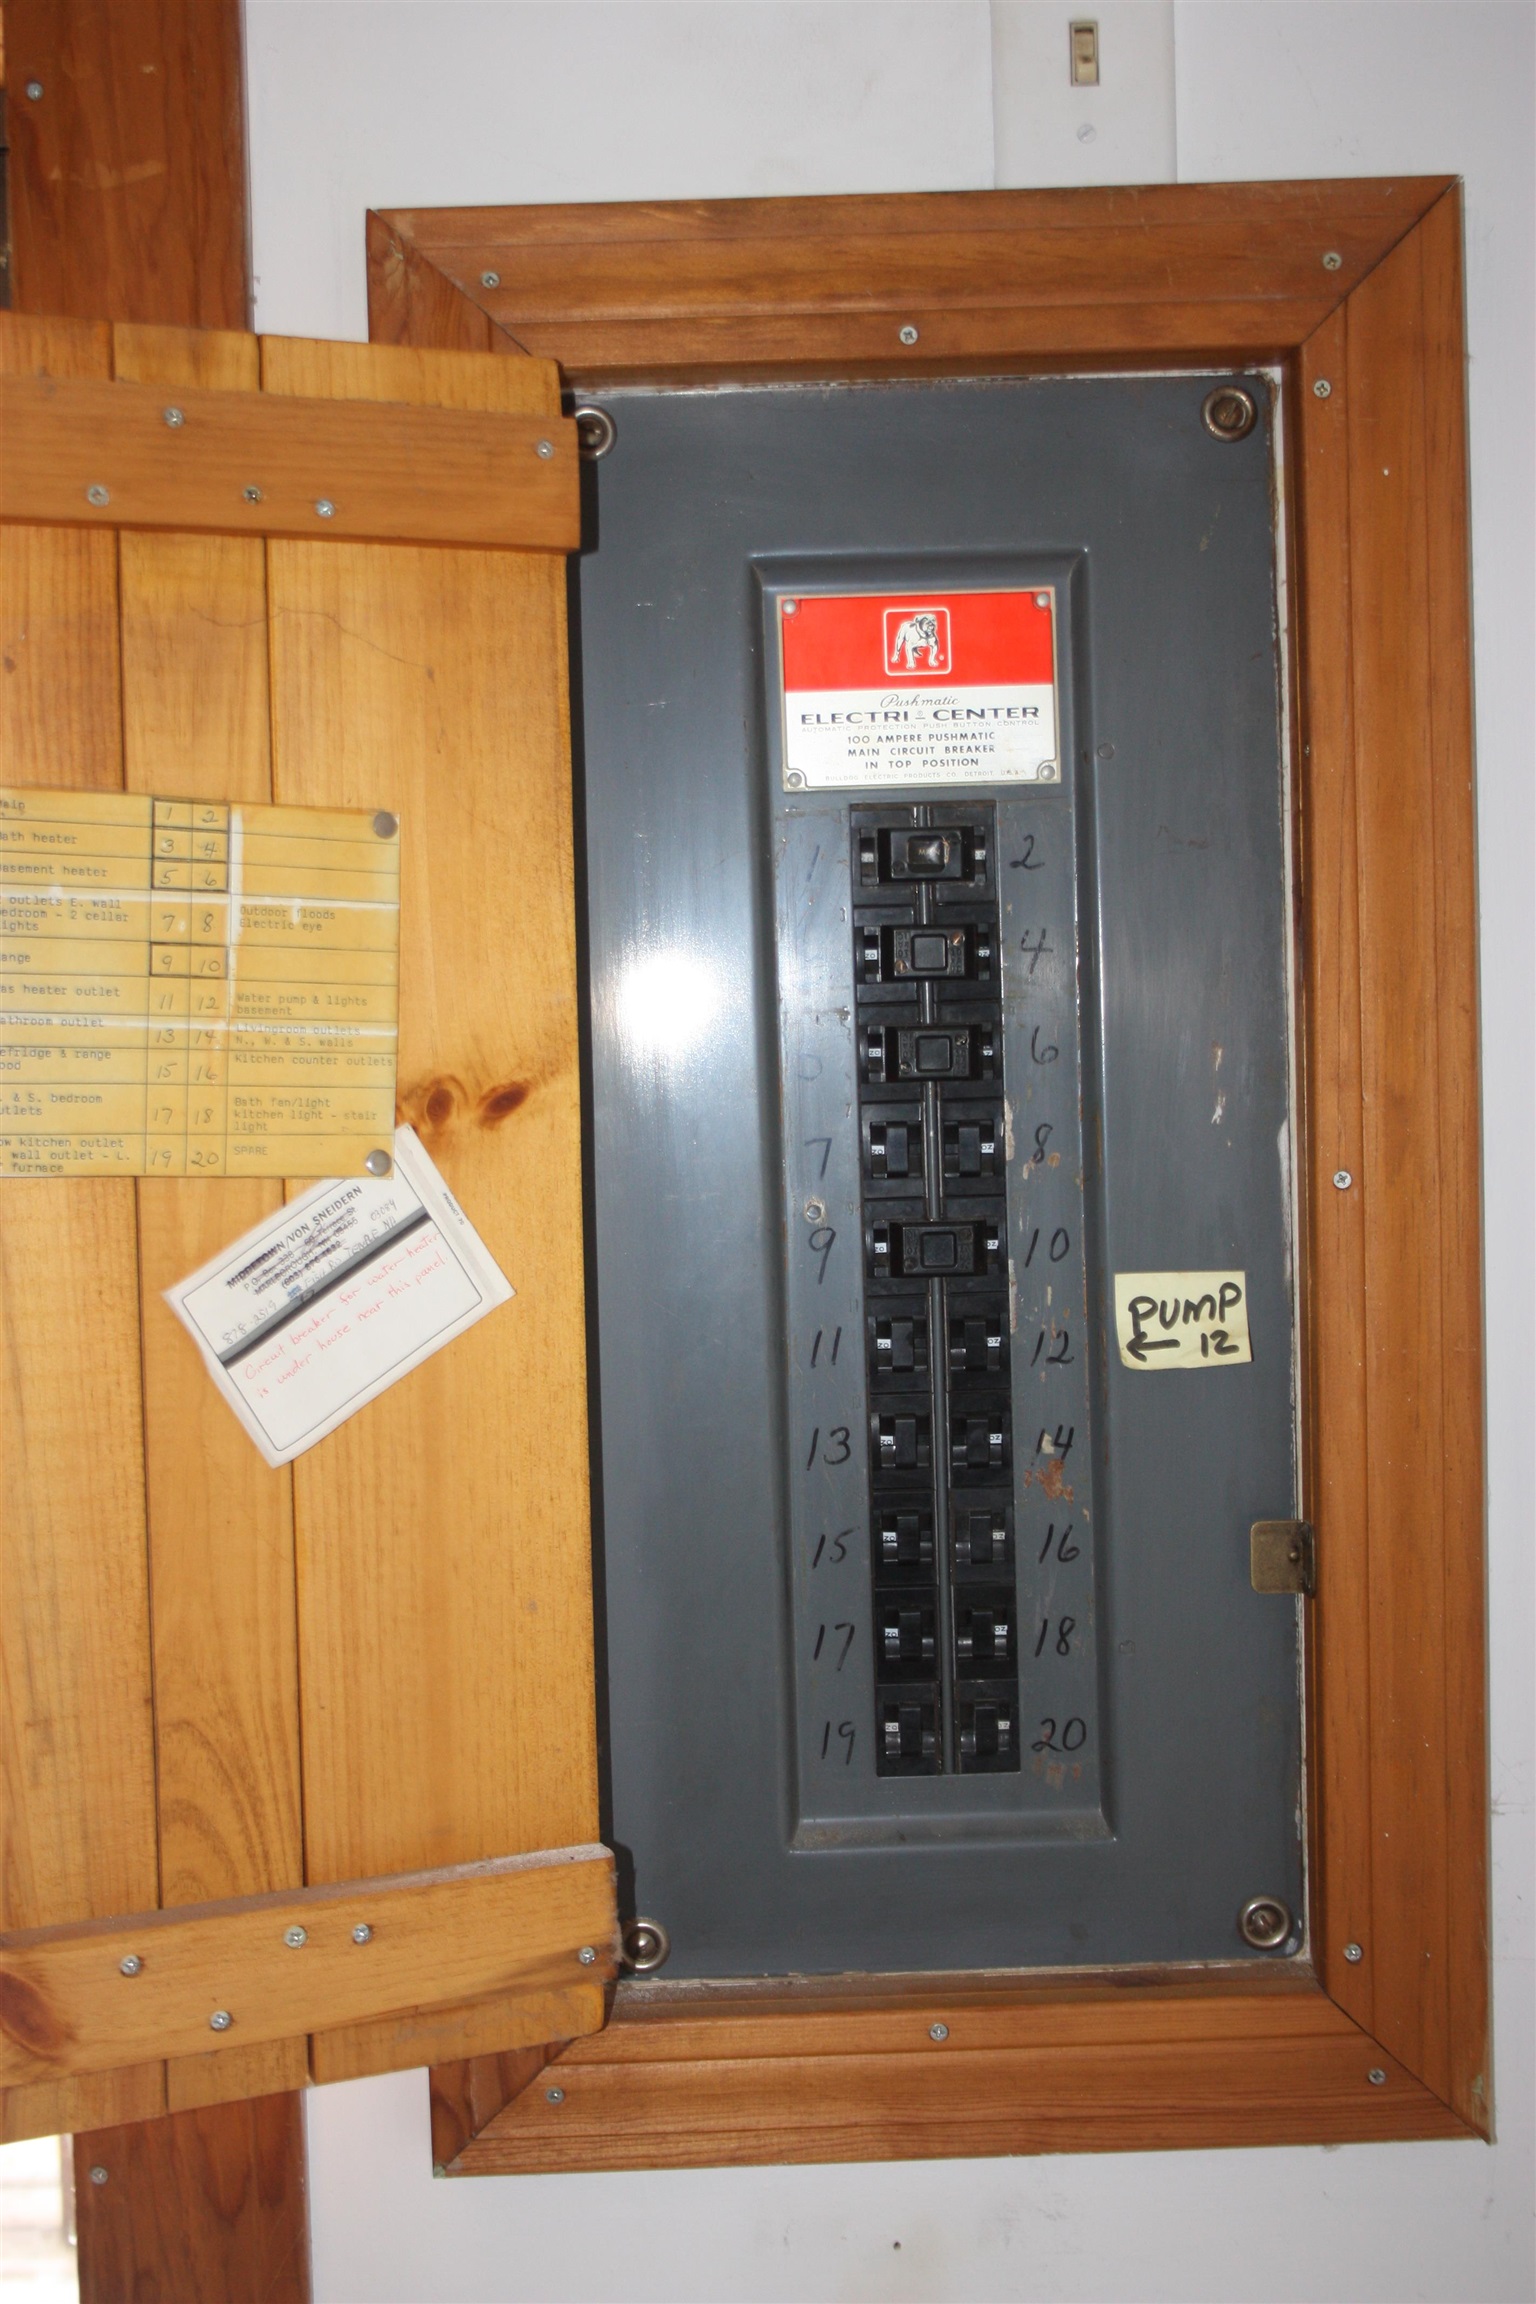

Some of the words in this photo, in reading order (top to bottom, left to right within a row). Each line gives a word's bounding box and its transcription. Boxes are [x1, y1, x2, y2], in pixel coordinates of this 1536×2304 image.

[880, 694, 959, 709] Pushmatic
[847, 735, 870, 744] 100
[876, 734, 922, 743] AMPERE
[928, 731, 996, 742] PUSHMATIC
[847, 748, 880, 757] MAIN
[890, 747, 935, 756] CIRCUIT
[944, 745, 996, 754] BREAKER
[865, 761, 878, 770] IN
[888, 760, 912, 769] TOP
[922, 758, 979, 768] POSITION
[166, 807, 173, 820] 1
[202, 810, 219, 824] 2
[32, 832, 78, 845] heater
[160, 839, 175, 854] 3
[203, 842, 218, 859] 4
[1009, 834, 1045, 870] 2
[0, 863, 55, 875] asement
[62, 866, 109, 878] heater
[160, 869, 179, 885] 5
[204, 871, 217, 887] 6
[9, 895, 63, 907] outlets
[70, 897, 84, 908] E.
[92, 899, 122, 910] wall
[0, 908, 48, 919] edroom
[70, 910, 78, 920] 2
[85, 911, 130, 923] cellar
[239, 906, 289, 919] Outdoor
[295, 908, 336, 920] floods
[0, 920, 40, 933] ights
[162, 914, 176, 933] 7
[202, 913, 214, 933] 8
[239, 918, 295, 930] Electric
[302, 922, 323, 934] eye
[0, 953, 31, 965] ange
[162, 955, 173, 972] 9
[1020, 928, 1054, 983] 4
[200, 959, 221, 974] 10
[23, 984, 68, 996] heater
[75, 986, 121, 997] outlet
[159, 993, 174, 1010] 11
[197, 995, 220, 1011] 12
[236, 992, 272, 1004] Water
[278, 995, 307, 1006] pump
[312, 995, 320, 1004] &
[326, 995, 368, 1007] lights
[236, 1005, 293, 1016] basement
[0, 1016, 54, 1027] athroom
[60, 1017, 105, 1028] outlet
[236, 1024, 307, 1036] Livingroom
[312, 1025, 361, 1036] outlets
[156, 1028, 176, 1044] 13
[195, 1029, 218, 1046] 14
[263, 1037, 277, 1047] W.
[284, 1037, 291, 1046] &
[299, 1037, 312, 1047] S.
[319, 1037, 354, 1048] walls
[1031, 1025, 1059, 1065] 6
[0, 1048, 52, 1060] efridge
[60, 1049, 68, 1059] &
[74, 1050, 112, 1062] range
[235, 1053, 285, 1065] Kitchen
[292, 1055, 339, 1065] counter
[346, 1056, 393, 1067] outlets
[157, 1063, 178, 1079] 15
[196, 1066, 218, 1081] 16
[13, 1093, 21, 1103] &
[27, 1093, 42, 1103] S.
[50, 1093, 103, 1104] bedroom
[234, 1097, 263, 1107] Bath
[269, 1097, 331, 1110] fan/light
[153, 1107, 173, 1126] 17
[194, 1107, 214, 1124] 18
[233, 1109, 290, 1120] kitchen
[291, 1110, 323, 1122] light
[343, 1111, 378, 1121] stair
[234, 1122, 268, 1133] light
[19, 1137, 72, 1148] kitchen
[79, 1138, 125, 1149] outlet
[234, 1146, 269, 1156] SPARE
[1032, 1123, 1054, 1164] 8
[12, 1150, 41, 1160] wall
[49, 1151, 95, 1161] outlet
[117, 1152, 131, 1161] L.
[152, 1150, 173, 1169] 19
[190, 1151, 220, 1168] 20
[804, 1137, 833, 1181] 7
[12, 1162, 65, 1174] furnace
[312, 1185, 363, 1226] SNEIDERN
[808, 1227, 837, 1285] 9
[1024, 1227, 1070, 1269] 10
[245, 1343, 286, 1380] Circuit
[289, 1308, 337, 1346] breaker
[339, 1287, 362, 1306] for
[367, 1256, 406, 1286] water
[405, 1232, 441, 1258] heater
[1127, 1281, 1243, 1337] PUMP
[257, 1387, 269, 1399] is
[277, 1353, 313, 1385] under
[316, 1324, 351, 1352] house
[357, 1300, 385, 1322] near
[388, 1281, 411, 1298] this
[810, 1326, 842, 1369] 11
[1200, 1329, 1240, 1359] 12
[1030, 1330, 1075, 1367] 12
[806, 1427, 851, 1471] 13
[1030, 1424, 1075, 1466] 14
[812, 1525, 861, 1570] 15
[1038, 1523, 1081, 1564] 16
[1034, 1616, 1076, 1658] 18
[813, 1622, 856, 1671] 17
[1030, 1717, 1087, 1752] 20
[821, 1720, 857, 1766] 19
